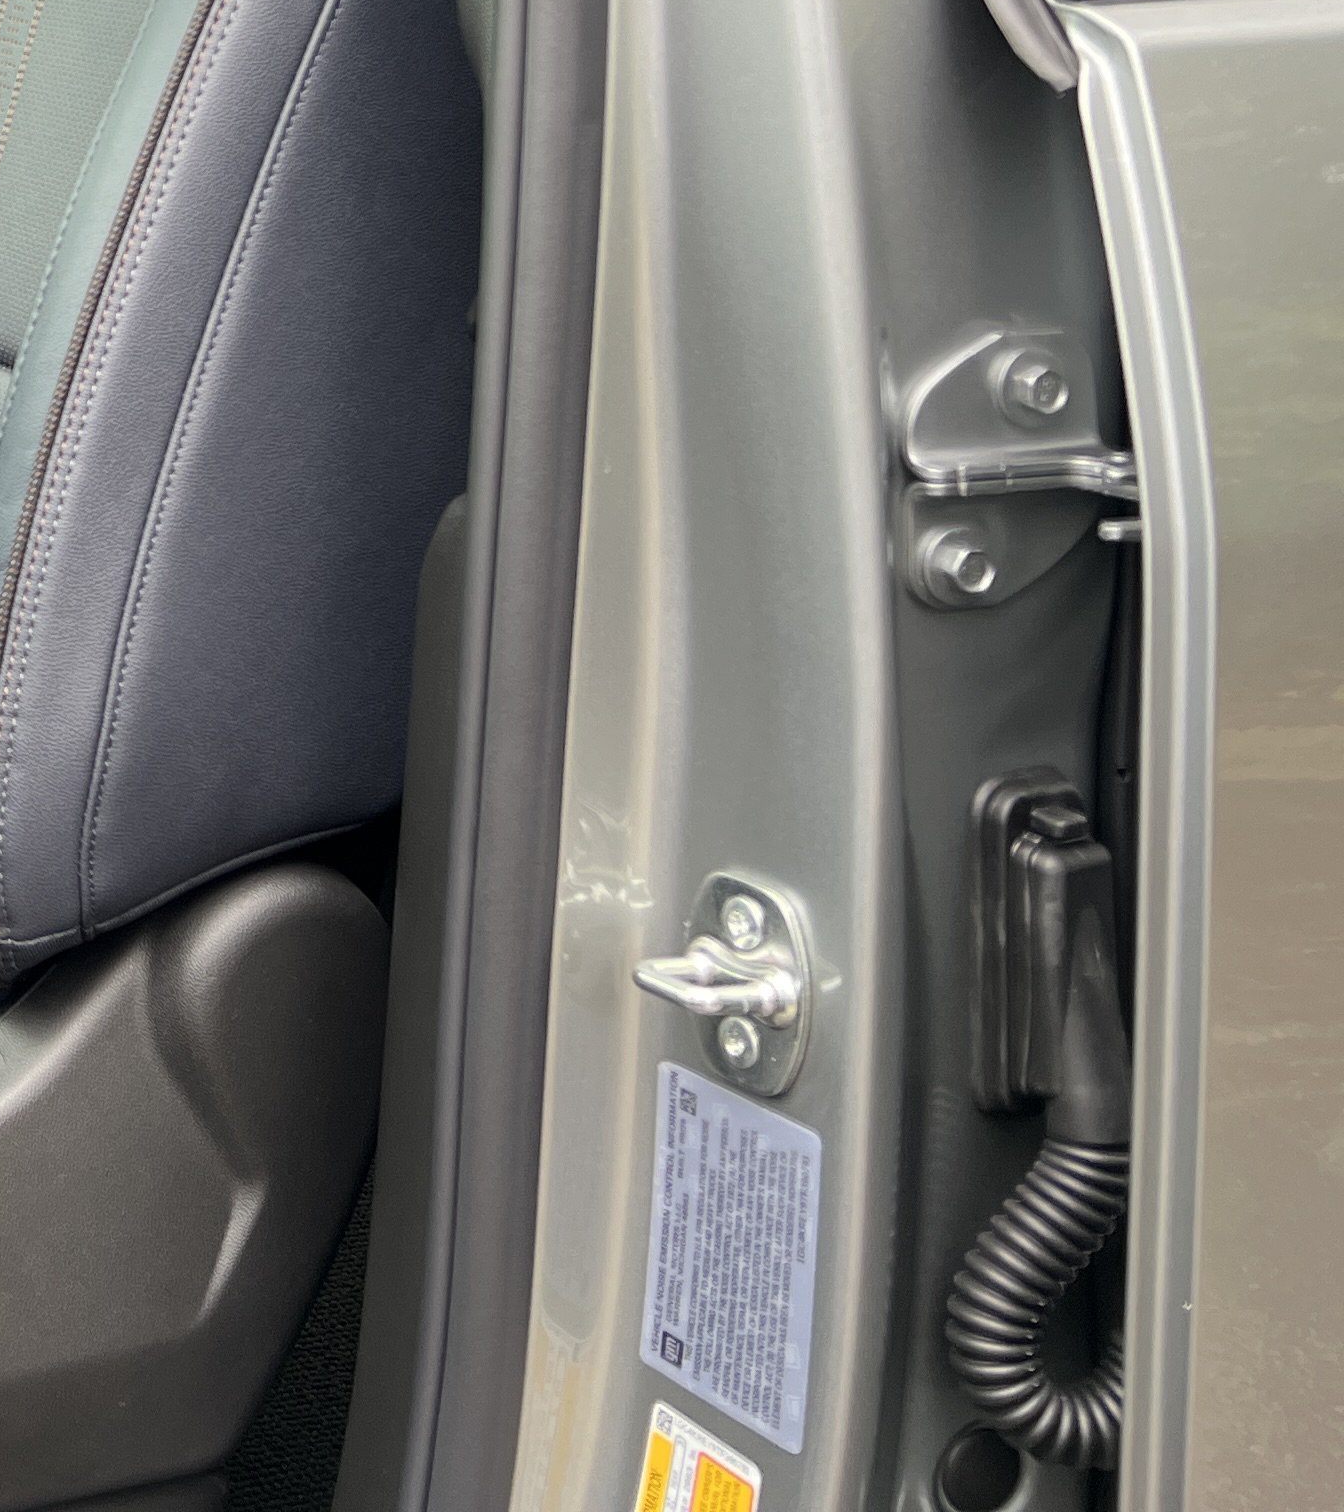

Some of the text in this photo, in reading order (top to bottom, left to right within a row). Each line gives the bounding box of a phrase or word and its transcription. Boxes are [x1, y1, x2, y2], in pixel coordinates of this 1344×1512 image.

[652, 1071, 679, 1353] VEHICLE NOISE EMISSION CONTROL INFORMATION
